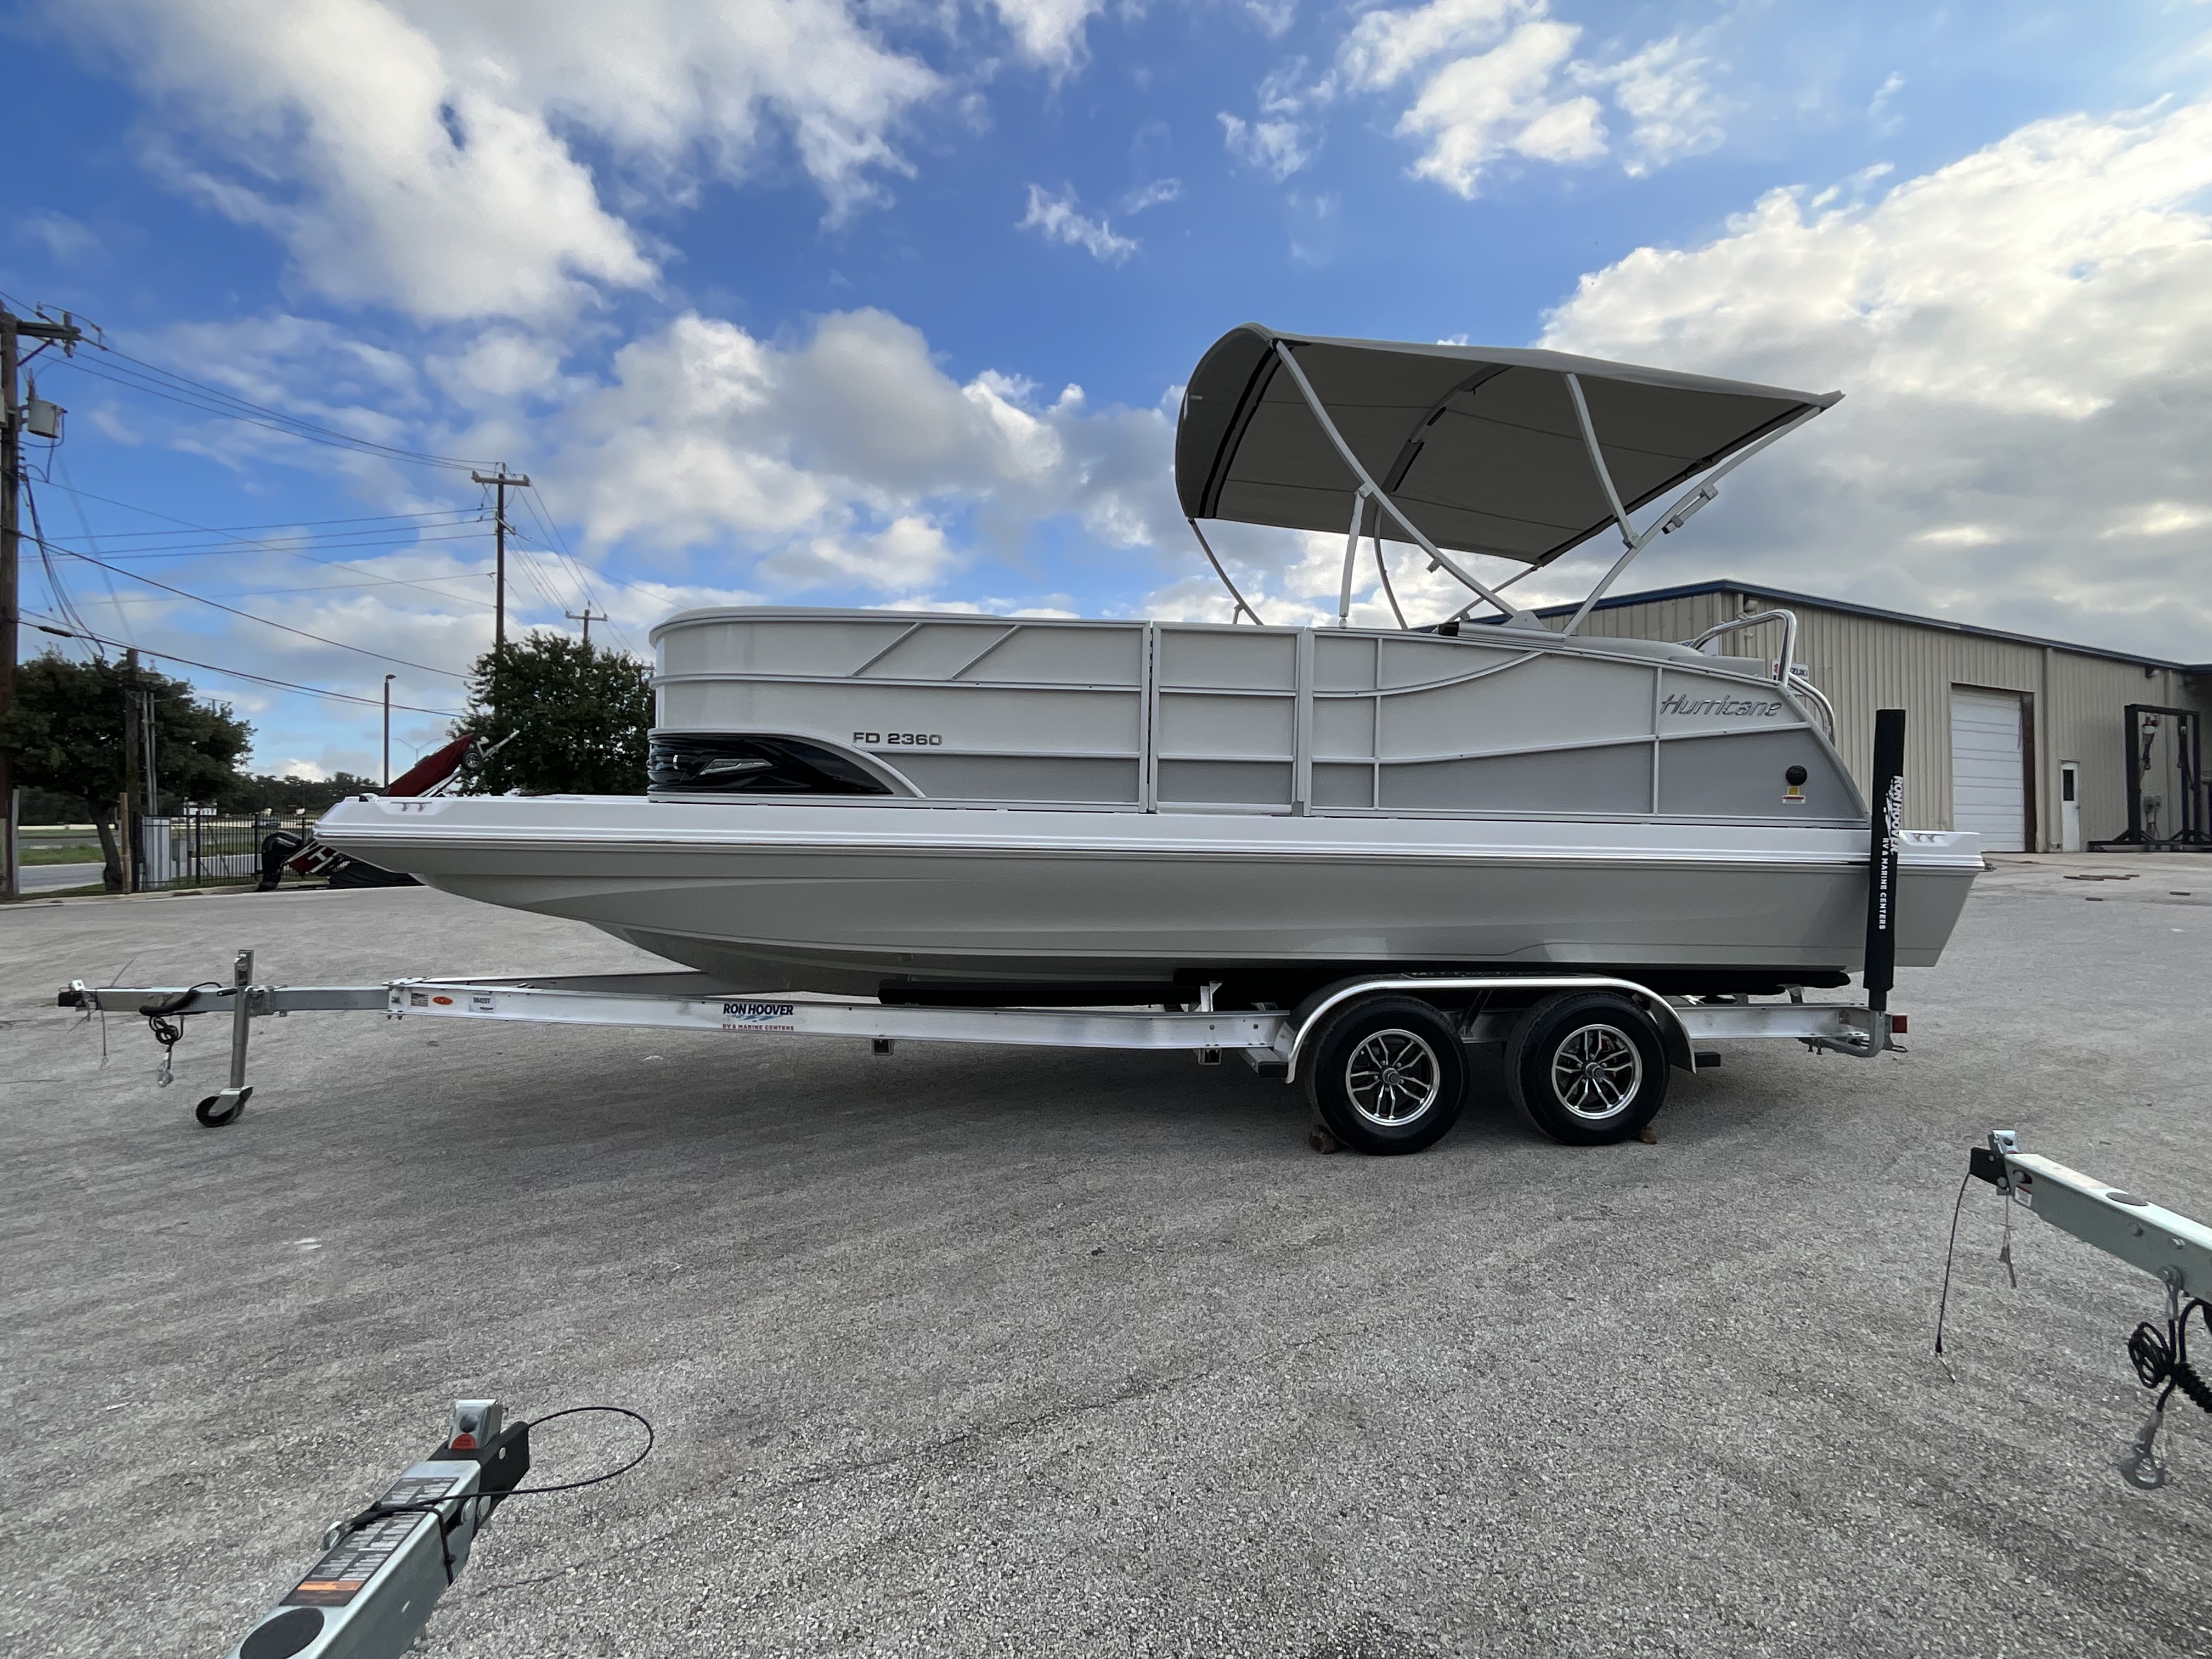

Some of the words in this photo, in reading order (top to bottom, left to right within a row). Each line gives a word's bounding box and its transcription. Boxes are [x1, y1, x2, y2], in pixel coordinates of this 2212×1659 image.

[1660, 693, 1782, 716] Hurricane
[853, 732, 881, 743] FD
[887, 733, 943, 746] 2360
[1893, 775, 1903, 802] RON
[1890, 802, 1903, 855] HOOVER
[1882, 837, 1889, 849] RV
[1880, 858, 1888, 890] MARINE
[1878, 892, 1887, 930] CENTERS
[723, 1003, 747, 1014] RON
[748, 1003, 794, 1015] HOOVER
